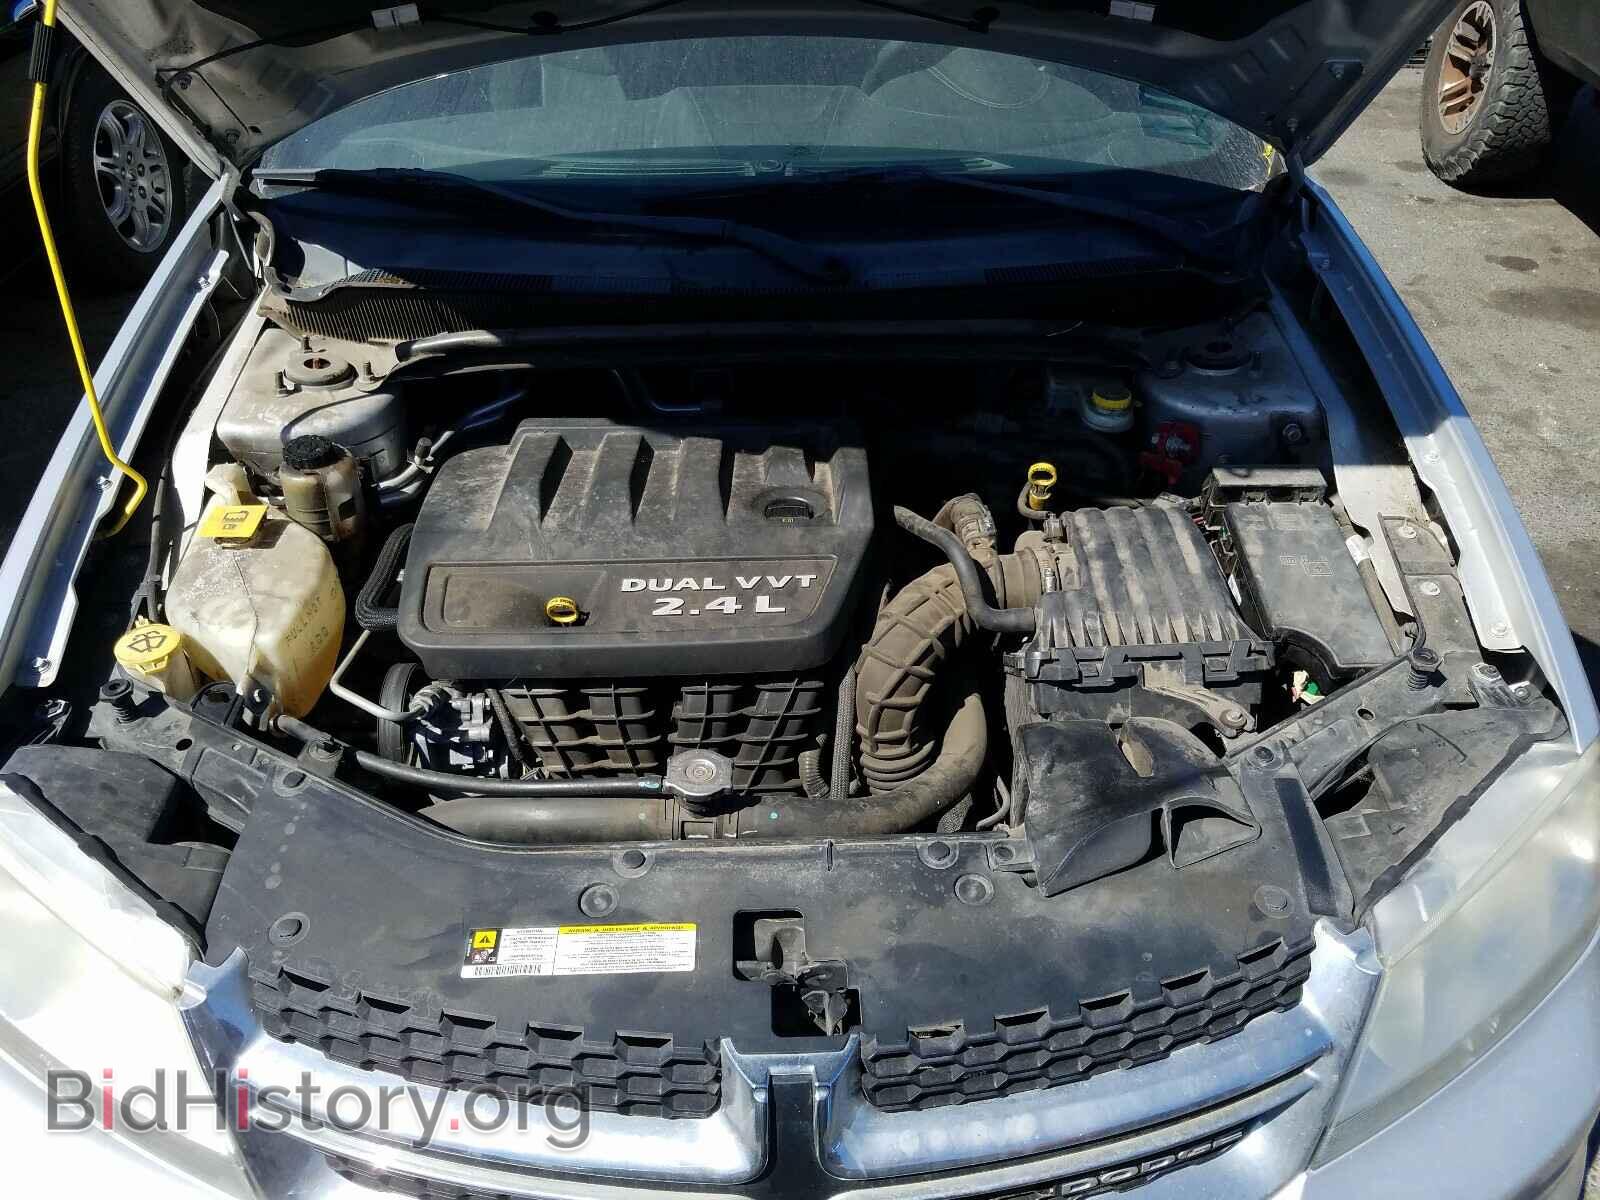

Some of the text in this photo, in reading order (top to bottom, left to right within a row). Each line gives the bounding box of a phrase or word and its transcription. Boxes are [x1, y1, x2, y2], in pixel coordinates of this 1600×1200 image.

[620, 574, 817, 592] DUAL VVT
[1061, 1130, 1244, 1196] DODGE
